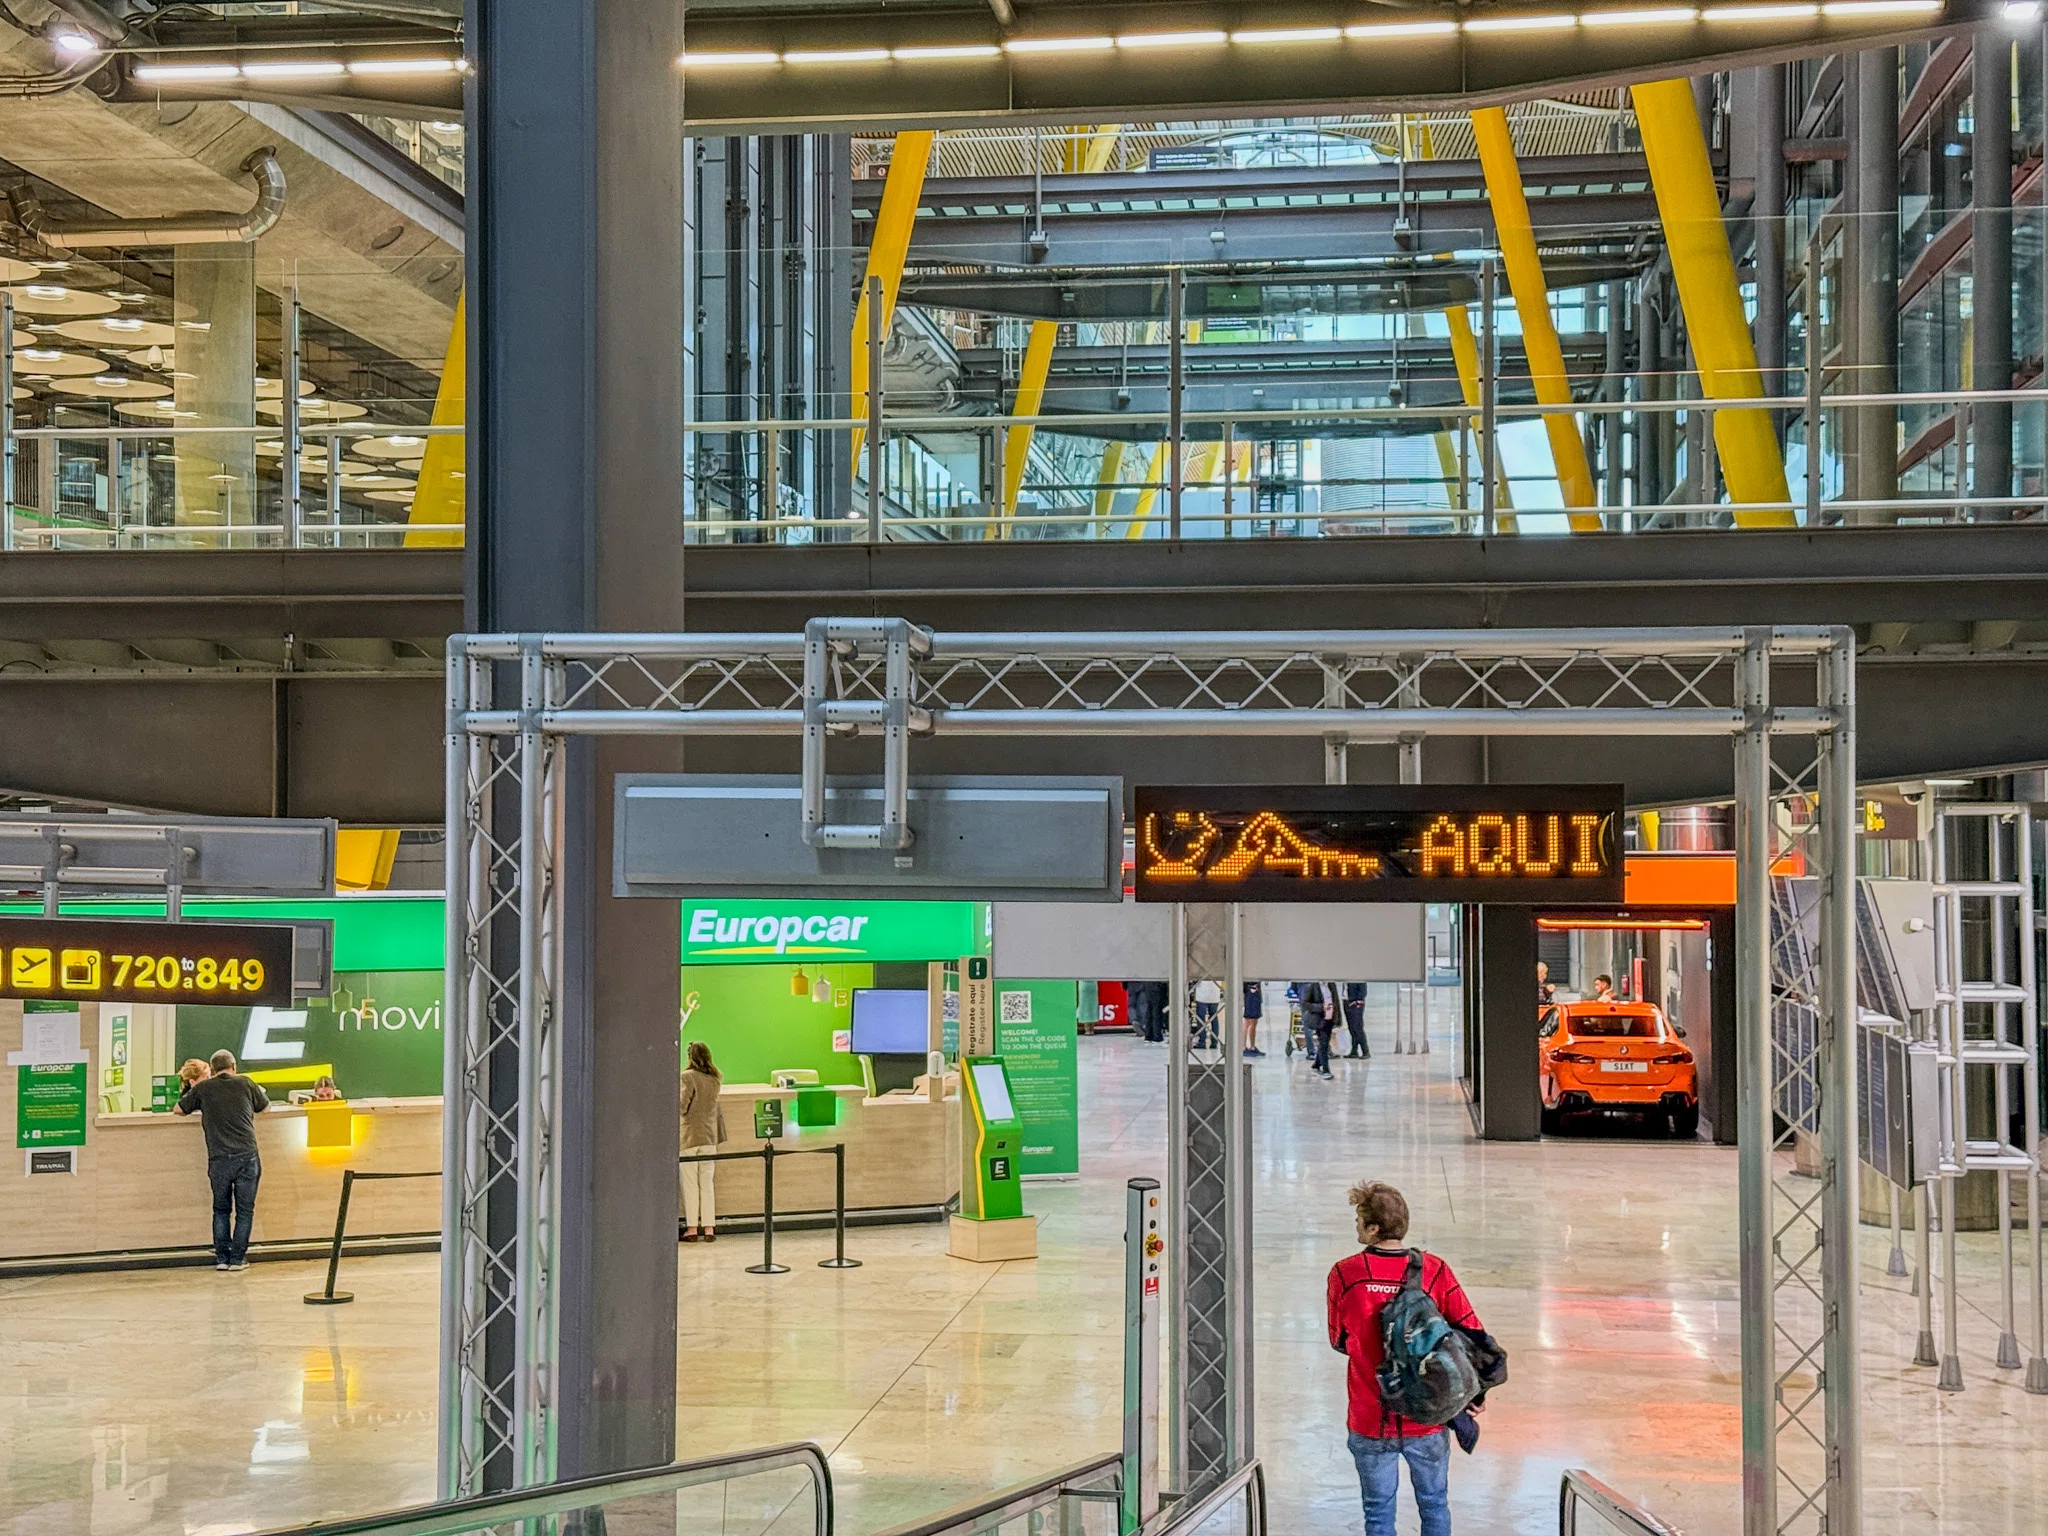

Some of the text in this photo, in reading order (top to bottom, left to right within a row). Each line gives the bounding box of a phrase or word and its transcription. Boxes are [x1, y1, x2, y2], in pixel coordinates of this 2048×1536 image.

[1422, 814, 1599, 873] AQUI
[688, 909, 868, 954] Europcar
[111, 954, 265, 991] 720 to a 849
[978, 983, 987, 1045] Register here
[1044, 1042, 1067, 1050] QUEUE
[30, 1063, 75, 1073] Europcar
[1613, 1062, 1634, 1071] SIXT
[1022, 1145, 1054, 1153] Europcar
[994, 1160, 1005, 1174] E
